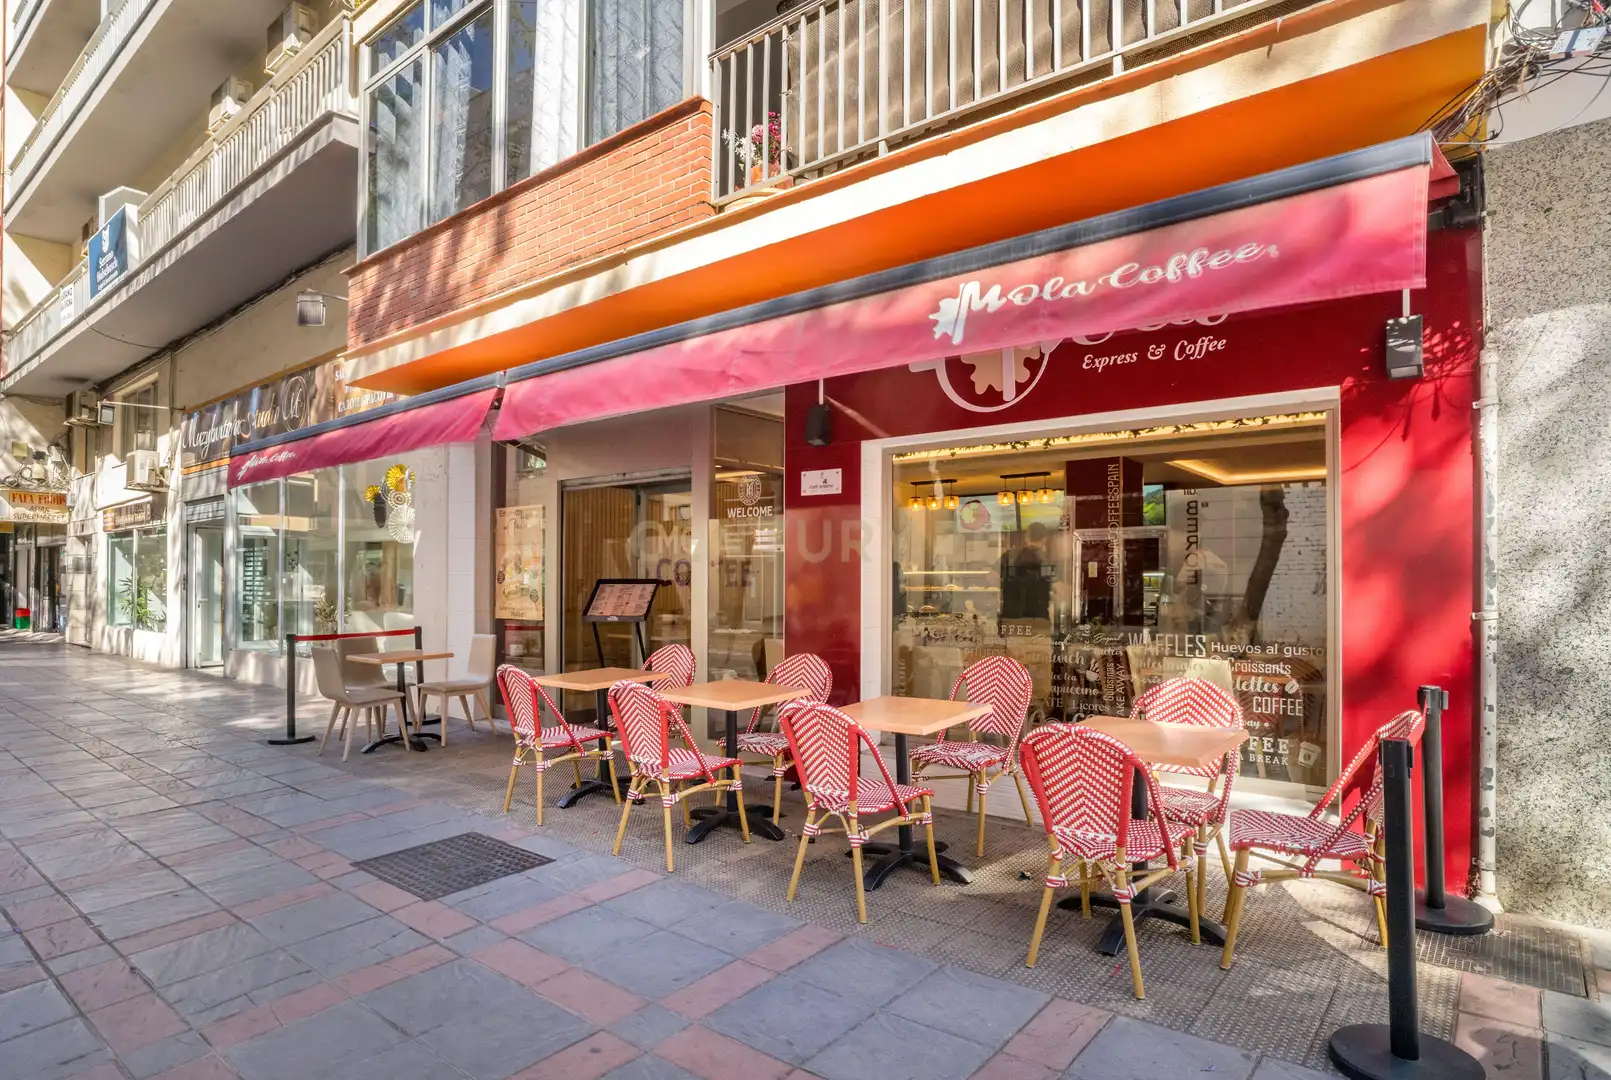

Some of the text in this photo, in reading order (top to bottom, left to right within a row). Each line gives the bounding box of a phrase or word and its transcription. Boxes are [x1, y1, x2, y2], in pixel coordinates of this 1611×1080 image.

[1082, 335, 1228, 372] Express & Coffee
[727, 505, 774, 519] WELCOME
[1128, 633, 1206, 658] WAFFLES
[1211, 641, 1325, 658] Huevos al gusto
[1227, 657, 1292, 674] Croissants
[1116, 663, 1125, 717] AKE AWAY
[1232, 676, 1280, 694] lettes
[1072, 699, 1110, 712] Licores
[1252, 696, 1303, 716] COFFEE
[1250, 752, 1289, 765] BREAK
